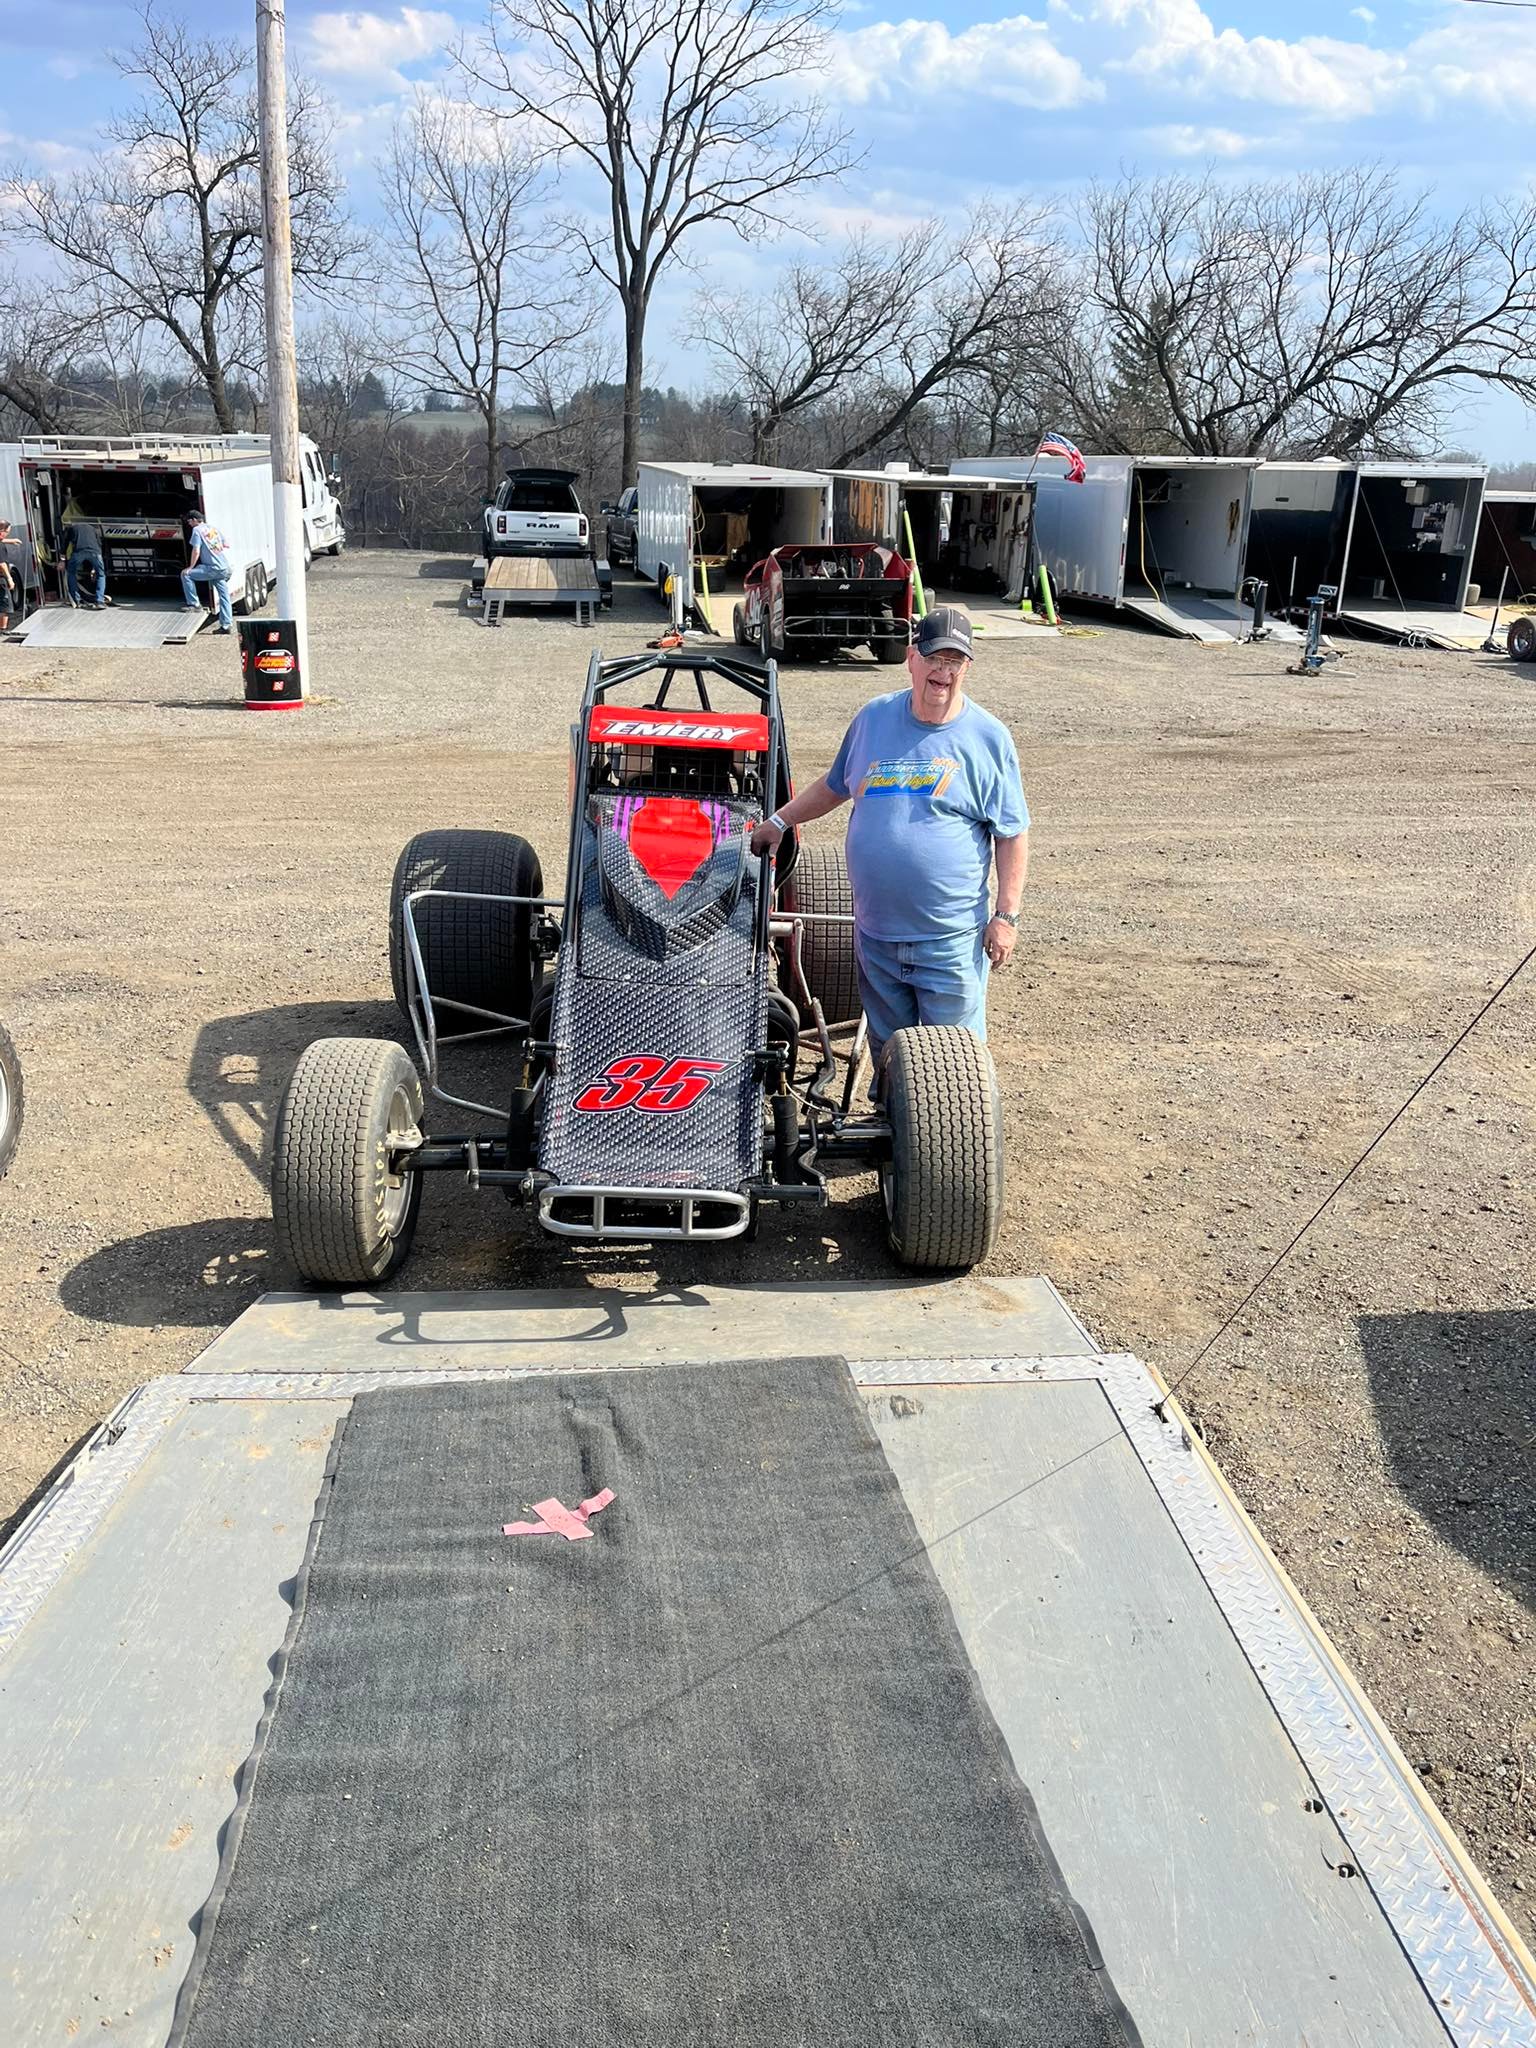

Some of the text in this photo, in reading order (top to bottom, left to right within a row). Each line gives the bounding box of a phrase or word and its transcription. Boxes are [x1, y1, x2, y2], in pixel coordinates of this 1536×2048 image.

[601, 719, 750, 742] EMERY
[920, 764, 960, 775] GROVE
[572, 1053, 741, 1115] 35
